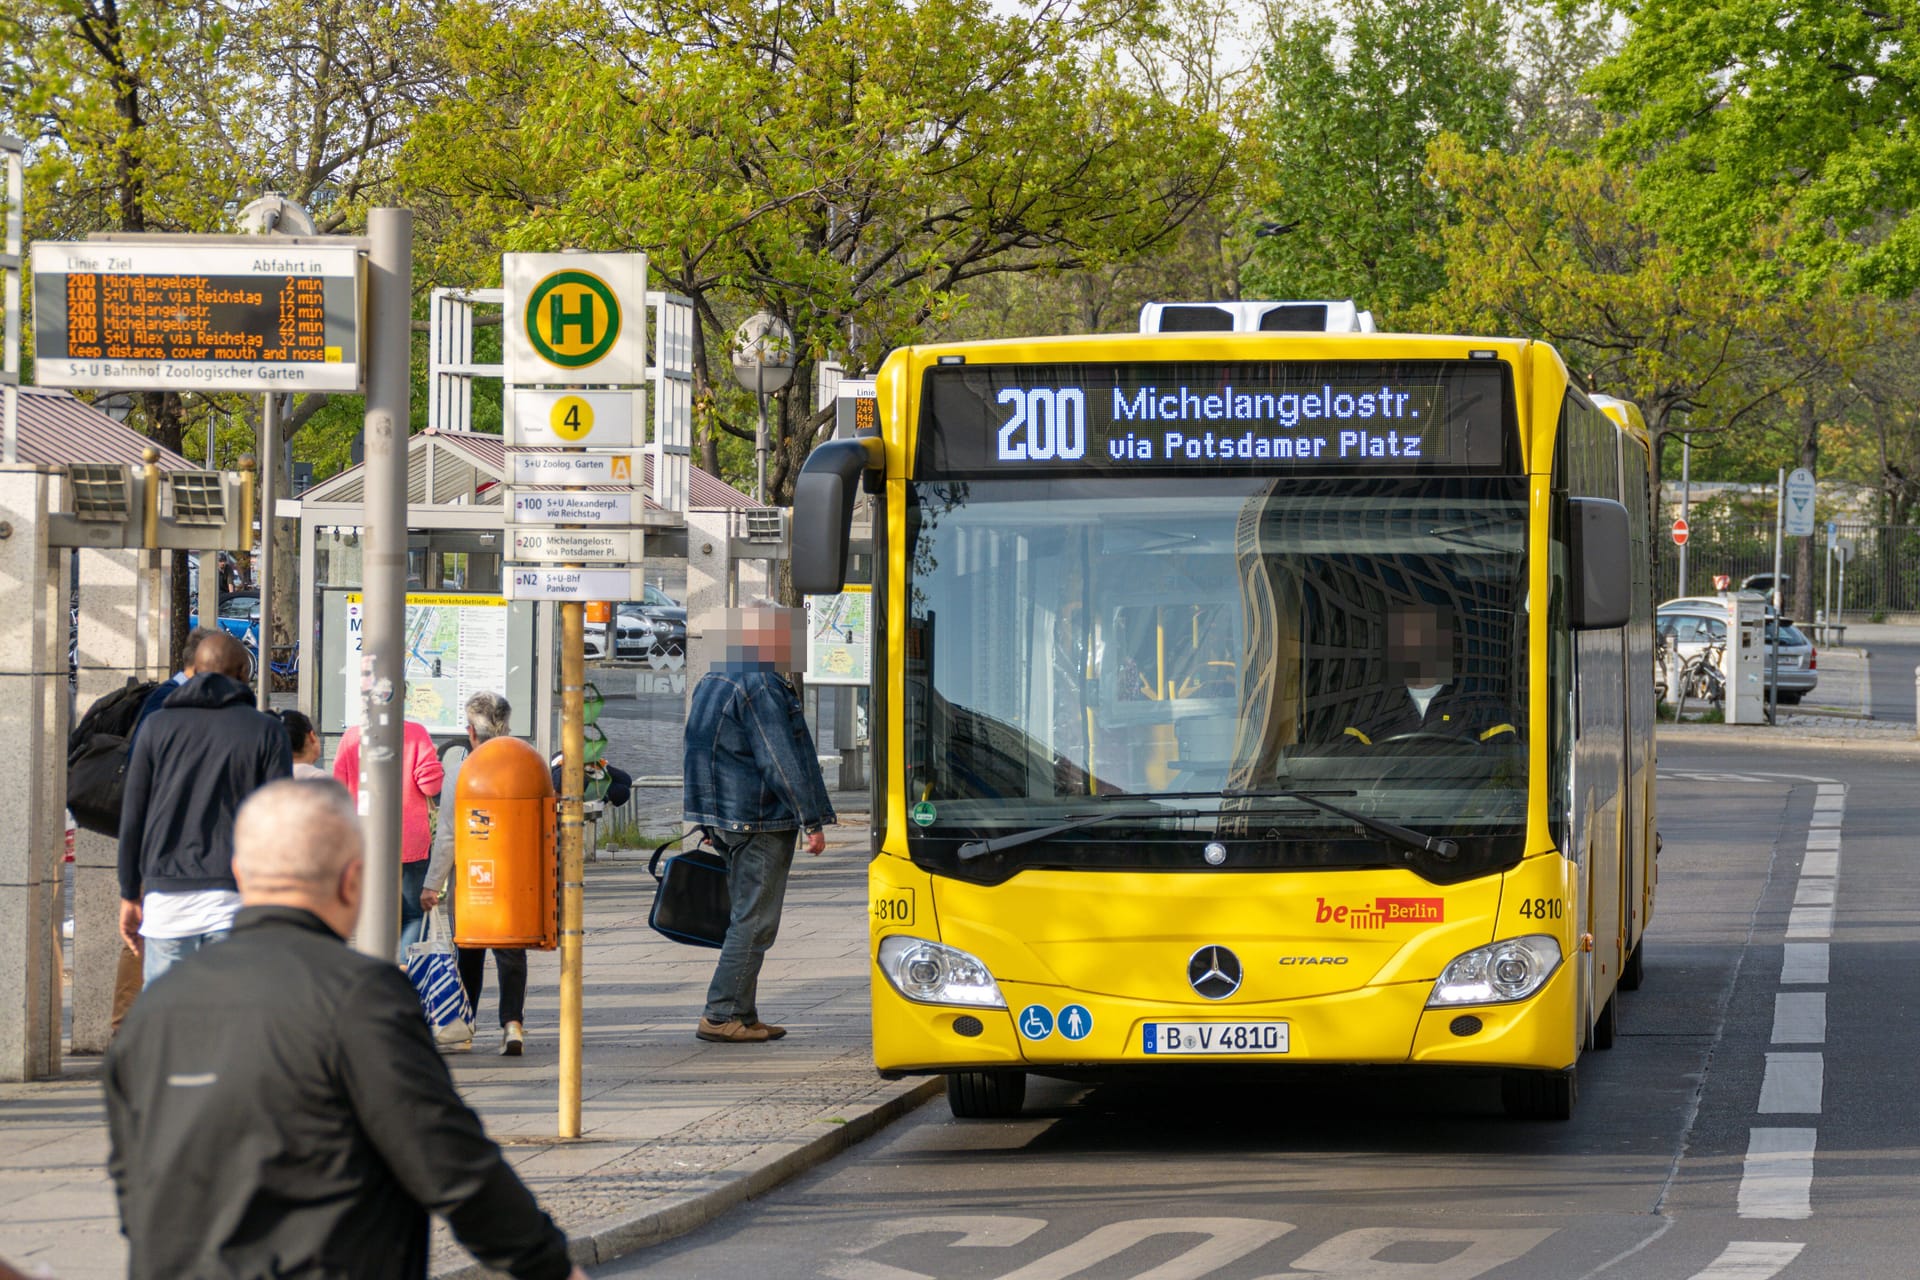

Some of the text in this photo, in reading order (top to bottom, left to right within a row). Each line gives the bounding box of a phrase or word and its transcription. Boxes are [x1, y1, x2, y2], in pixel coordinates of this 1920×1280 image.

[67, 258, 132, 270] Linie Ziel
[252, 259, 322, 273] Abfahrt in
[67, 273, 323, 291] 200 Michelangelostr. 2 min
[67, 287, 323, 306] 100 S+U Alex via Reichstag 12 min
[68, 302, 323, 318] 200 Michelangelostr. 12 min
[68, 316, 323, 333] 200 Michelangelostr. 22 min
[550, 293, 594, 346] H
[68, 330, 323, 347] 100 S+U Alex via Reichstag 32 min
[68, 344, 102, 359] Keep
[107, 345, 167, 359] distance,
[171, 347, 209, 359] cover
[214, 346, 256, 360] mouth
[262, 347, 287, 360] and
[292, 348, 323, 361] nose
[104, 364, 161, 377] Bahnhof
[166, 365, 253, 381] Zoologischer
[257, 366, 305, 380] Garten
[857, 397, 874, 405] M46
[857, 405, 873, 413] 249
[563, 404, 581, 432] 4
[857, 413, 874, 421] M46
[997, 385, 1419, 460] 200 Michelangelostr.
[1109, 431, 1423, 459] via Potsdamer Platz
[524, 459, 541, 468] S+U
[575, 460, 604, 469] Garten
[524, 498, 618, 510] 100 S+U Alexanderpl.
[547, 509, 601, 519] via Reichstag
[523, 536, 614, 548] 200 Michelangelostr.
[546, 548, 558, 556] via
[560, 548, 604, 556] Potsdamer
[523, 574, 537, 585] N2
[546, 584, 578, 593] Pankow
[874, 899, 909, 920] 4810
[1388, 903, 1438, 919] Berlin
[1519, 898, 1562, 920] 4810
[1278, 956, 1348, 965] CITARO
[1166, 1027, 1181, 1050] B
[1198, 1026, 1213, 1050] V
[1219, 1026, 1279, 1050] 4810
